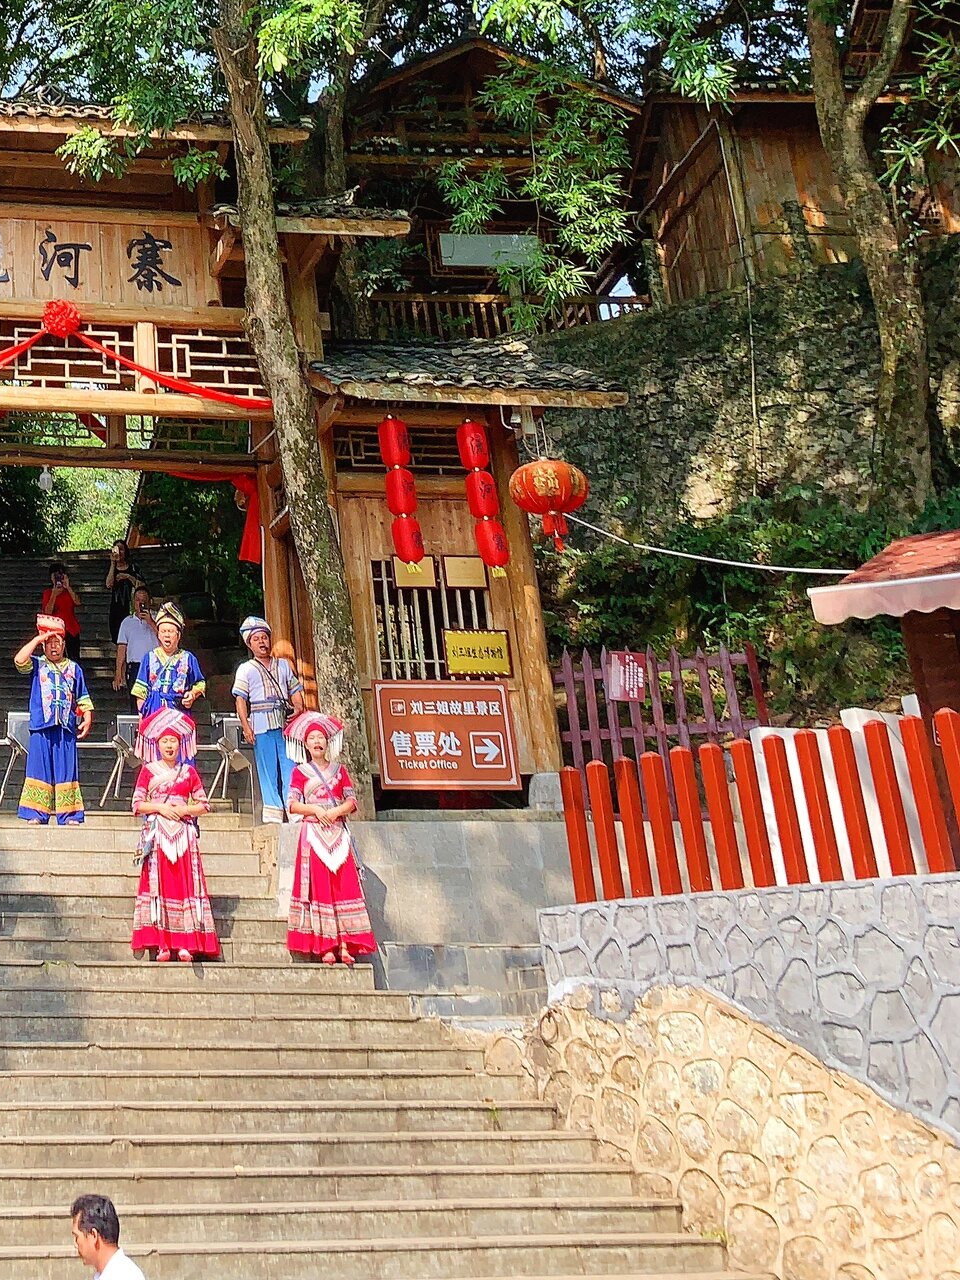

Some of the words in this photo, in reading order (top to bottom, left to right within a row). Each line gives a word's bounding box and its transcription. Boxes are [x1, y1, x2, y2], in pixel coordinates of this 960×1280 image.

[410, 700, 502, 716] 刘三姐故里景区
[390, 730, 462, 757] 售票处
[398, 759, 428, 769] Ticket
[429, 759, 458, 770] Office
